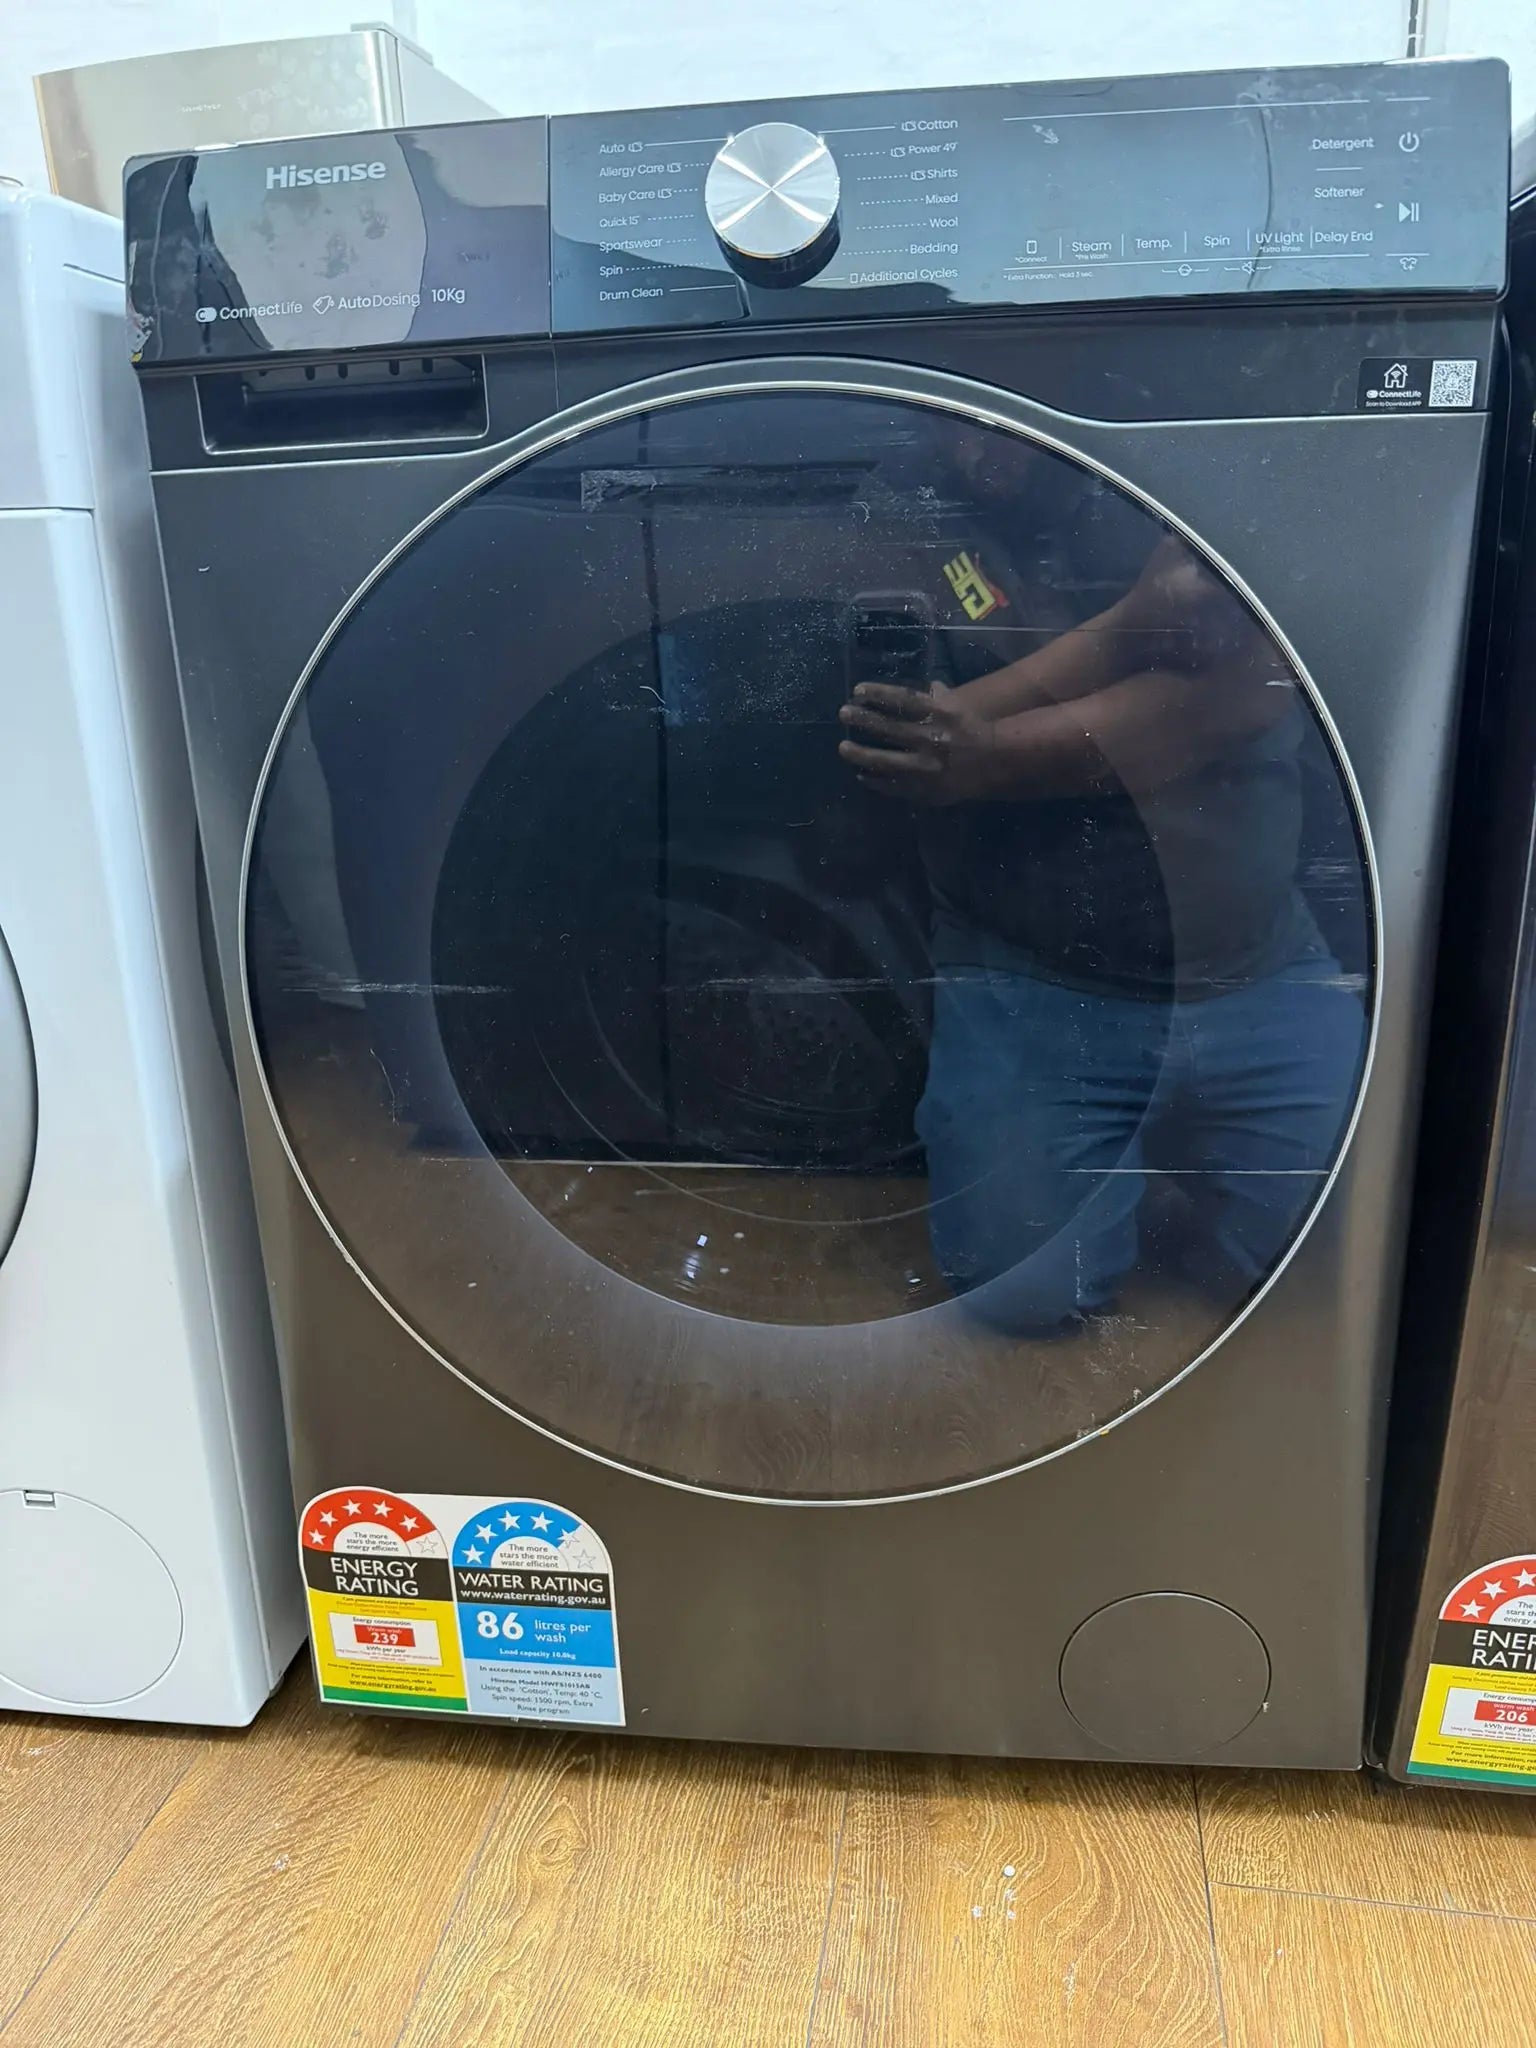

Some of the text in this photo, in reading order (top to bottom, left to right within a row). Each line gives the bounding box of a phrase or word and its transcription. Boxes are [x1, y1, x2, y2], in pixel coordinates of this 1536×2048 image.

[917, 120, 958, 131] Cotton
[600, 144, 625, 153] Auto
[908, 145, 940, 154] Power
[1312, 138, 1374, 151] Detergent
[266, 162, 386, 189] Hisense
[600, 164, 664, 178] Allergy Care
[927, 169, 958, 179] Shirts
[599, 190, 656, 203] Baby Care
[925, 193, 958, 204] Mixed
[1314, 187, 1364, 198] Softener
[600, 217, 627, 228] Quick
[929, 217, 958, 228] Wool
[1203, 235, 1230, 248] Spin
[1255, 232, 1304, 245] UV Light
[1314, 231, 1373, 244] Delay End
[600, 239, 663, 253] Sportswear
[910, 243, 958, 254] Bedding
[1071, 242, 1112, 252] Steam
[1135, 238, 1173, 250] Temp.
[600, 265, 623, 277] Spin
[860, 267, 958, 282] Additional Cycles
[431, 287, 466, 305] 10Kg
[600, 287, 664, 301] Drum Clean
[337, 291, 421, 310] AutoDosing
[219, 301, 303, 320] ConnectLife
[330, 1557, 418, 1579] ENERGY
[526, 1560, 560, 1568] efficient
[335, 1575, 419, 1597] RATING
[458, 1572, 604, 1593] WATER RATING
[460, 1589, 606, 1605] www.waterrating.gov.au
[1518, 1601, 1534, 1609] The
[353, 1616, 412, 1627] Energy consumption
[476, 1610, 524, 1640] 86
[534, 1619, 592, 1634] litres per
[1503, 1616, 1531, 1625] energy
[371, 1632, 399, 1645] 239
[534, 1633, 567, 1644] wash
[1471, 1648, 1536, 1671] RATI
[489, 1667, 532, 1675] accordance
[480, 1684, 501, 1693] Using
[491, 1694, 508, 1702] Spin
[1483, 1692, 1505, 1700] Energy
[517, 1704, 571, 1715] Rinse program
[1495, 1709, 1529, 1723] 206
[1484, 1722, 1503, 1730] kWh
